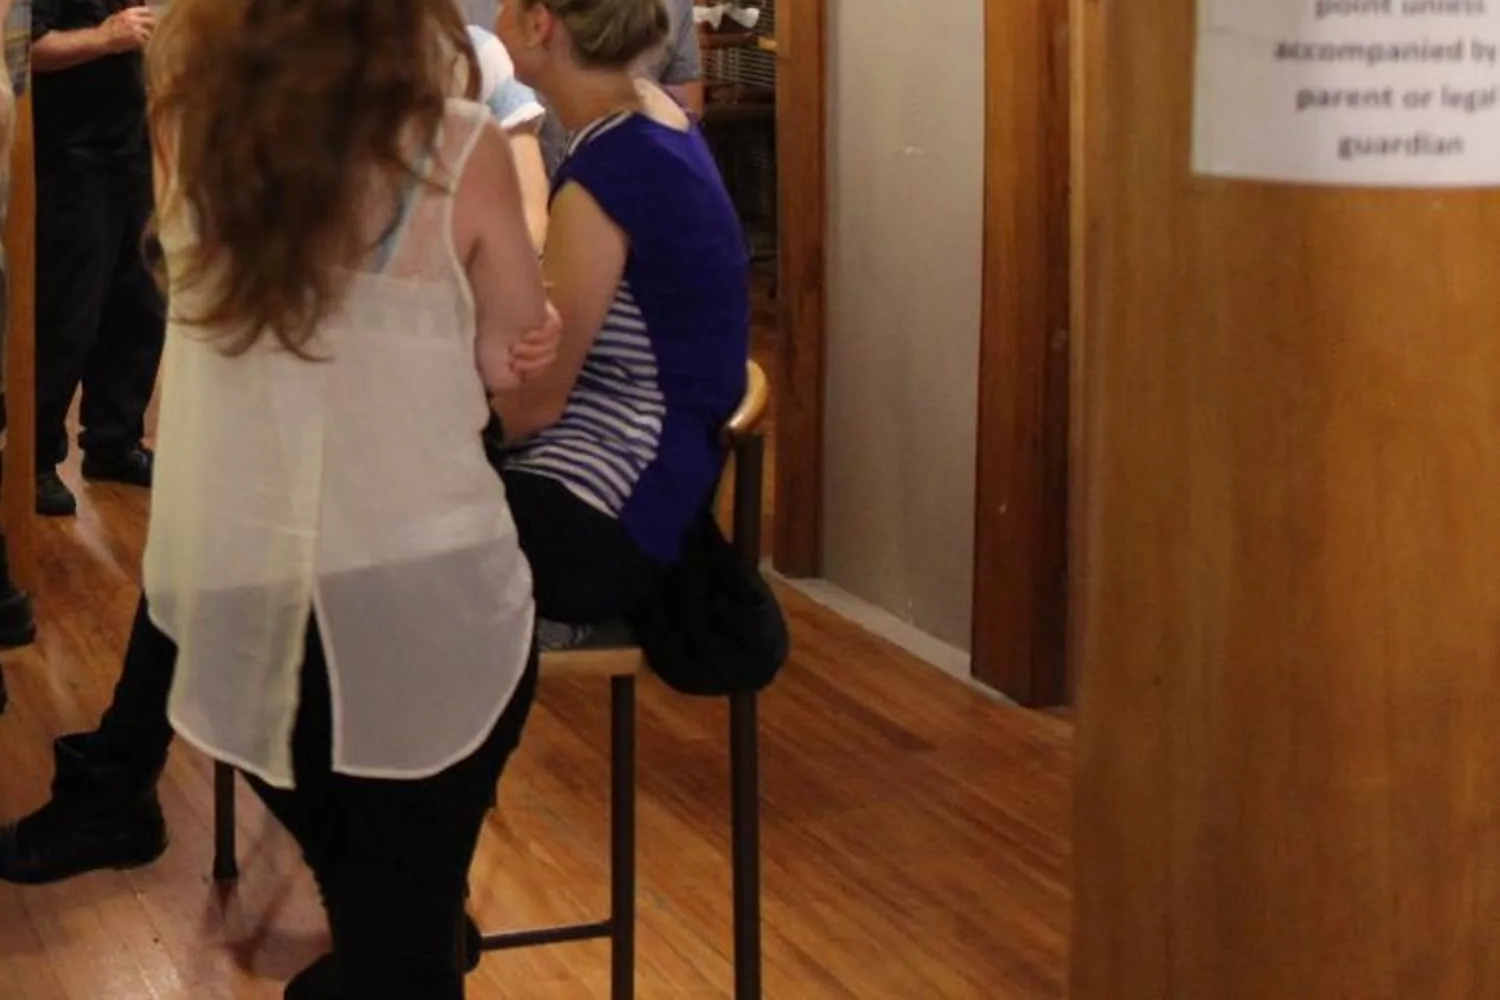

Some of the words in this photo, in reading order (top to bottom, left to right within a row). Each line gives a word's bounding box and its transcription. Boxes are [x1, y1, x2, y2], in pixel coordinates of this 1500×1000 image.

[1274, 36, 1463, 67] accompanied
[1471, 36, 1497, 66] by
[1295, 85, 1392, 113] parent
[1403, 89, 1431, 109] or
[1441, 83, 1497, 113] legal
[1337, 130, 1464, 160] guardian
